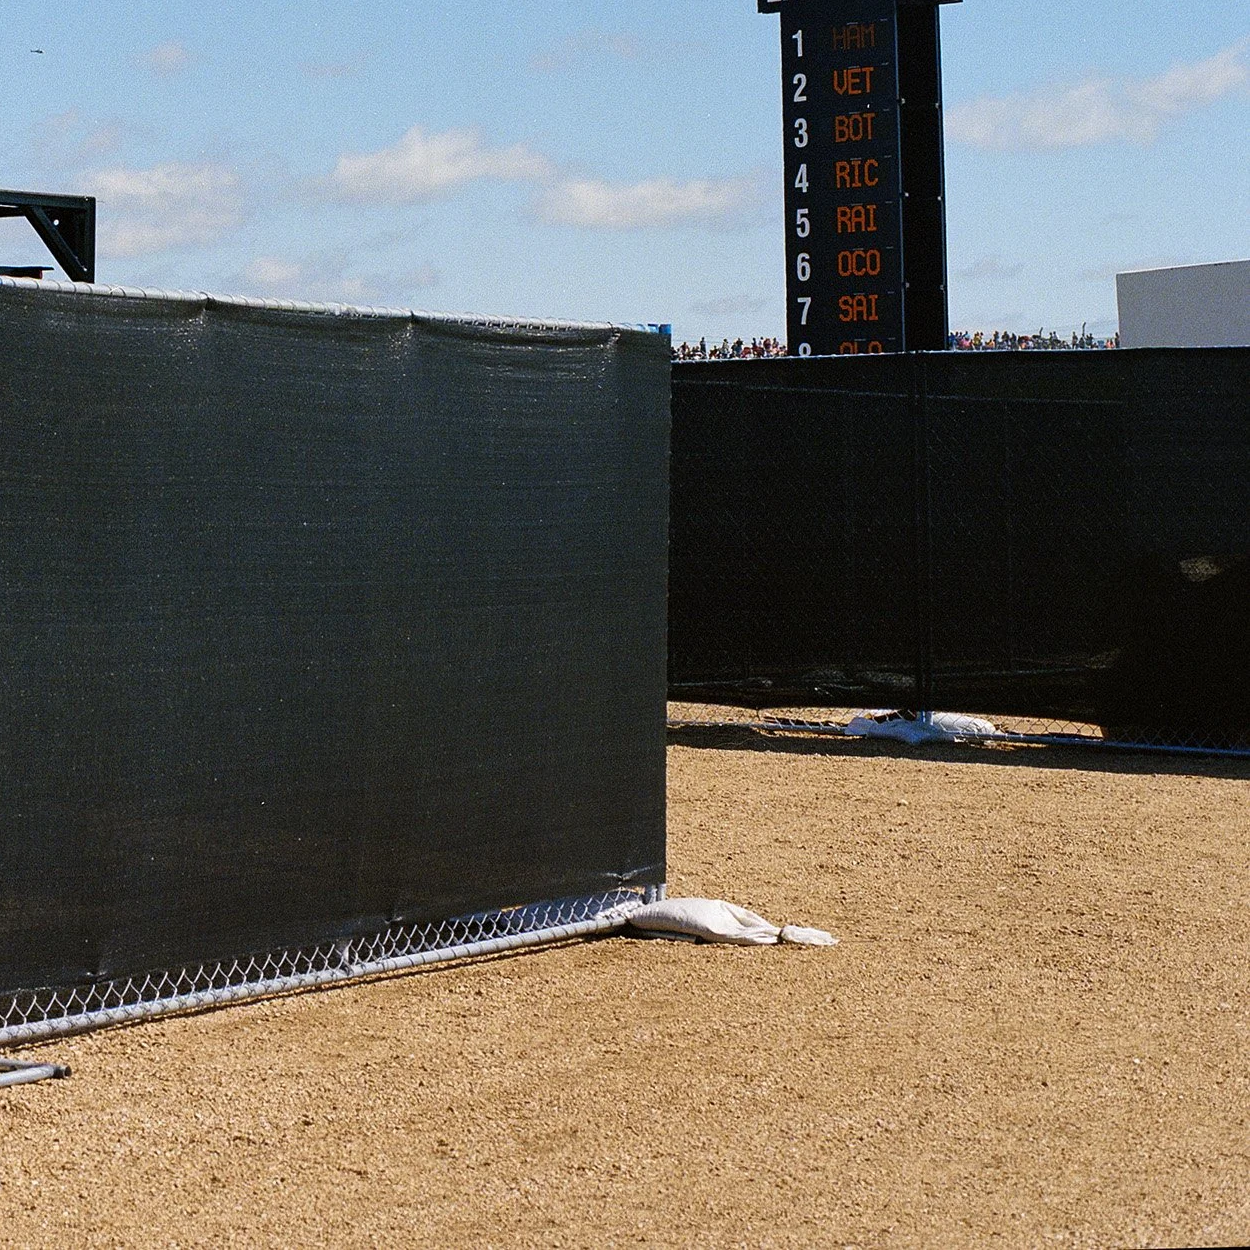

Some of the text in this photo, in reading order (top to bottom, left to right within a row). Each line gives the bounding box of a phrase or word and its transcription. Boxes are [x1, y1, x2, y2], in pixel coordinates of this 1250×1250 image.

[792, 23, 875, 57] 1 HAM
[792, 66, 874, 103] 2 VET
[794, 112, 875, 148] 3 BOT
[794, 159, 879, 193] 4 RIC
[796, 204, 878, 238] 5 RAI
[796, 249, 881, 282] 6 OCO
[797, 294, 879, 325] 7 SAI
